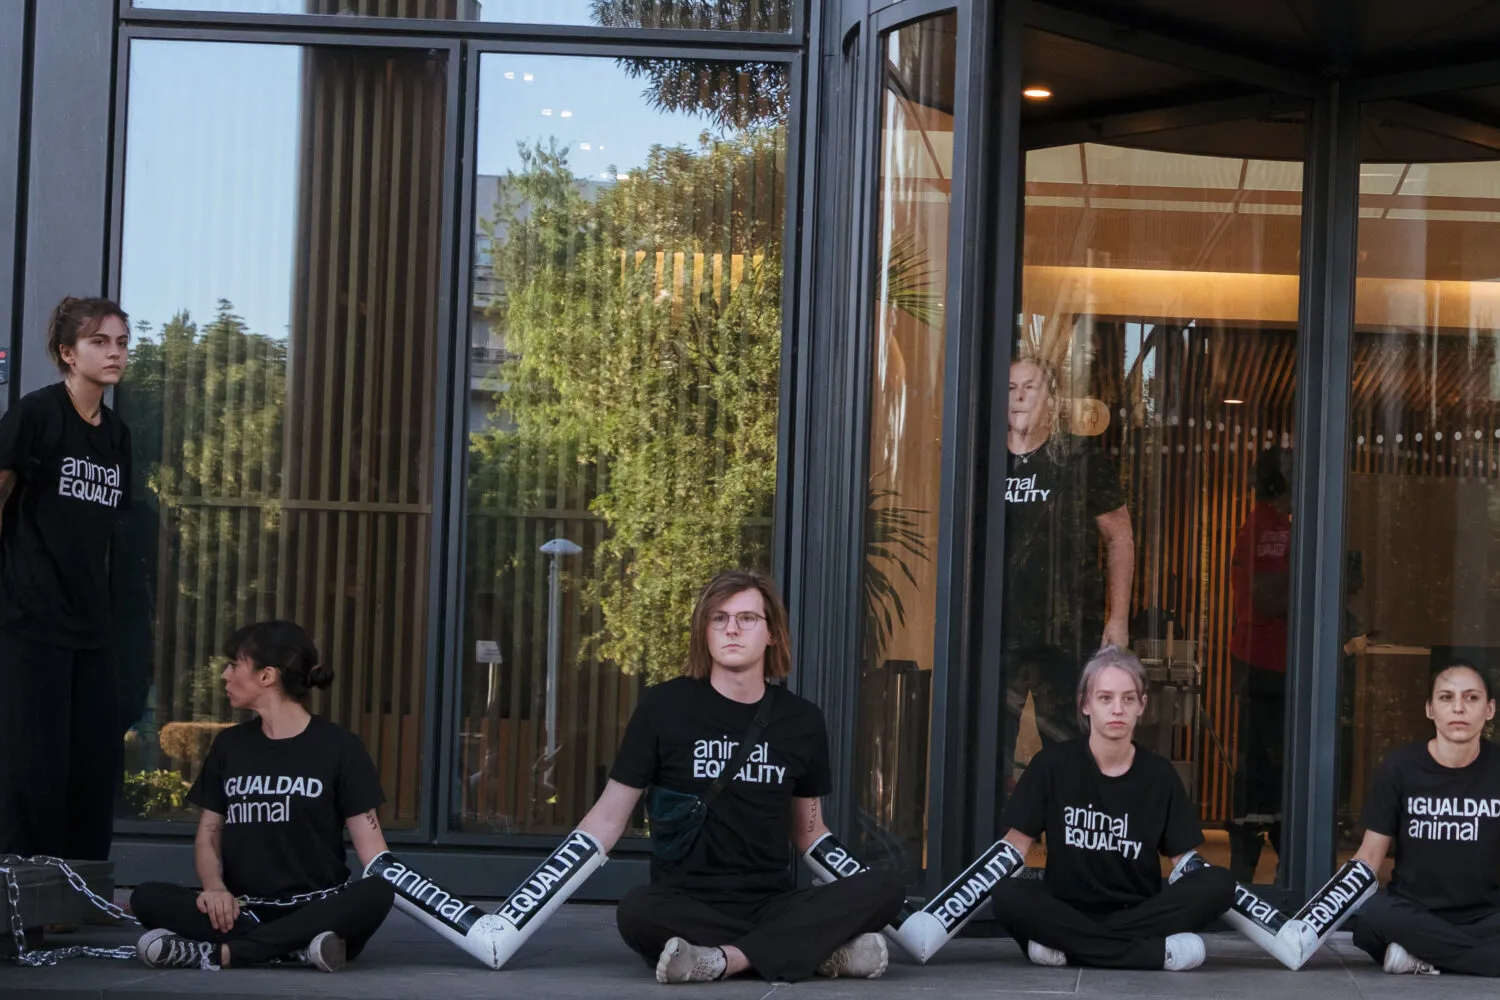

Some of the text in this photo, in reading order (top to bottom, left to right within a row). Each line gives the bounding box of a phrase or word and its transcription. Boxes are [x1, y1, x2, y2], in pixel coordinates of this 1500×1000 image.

[60, 455, 120, 488] animal
[1005, 473, 1037, 490] mal
[58, 476, 123, 508] EQUALIT
[1004, 489, 1051, 503] ALITY
[223, 775, 323, 798] GUALDAD
[693, 759, 786, 784] EQALITY
[1063, 803, 1128, 839] animal
[1408, 815, 1479, 842] animal
[1065, 825, 1142, 860] EQUALITY
[383, 862, 474, 924] animal
[500, 833, 593, 925] EQUALITY
[933, 846, 1018, 929] EQUALITY
[1235, 883, 1280, 925] mal
[1303, 861, 1371, 932] EQUALITY
